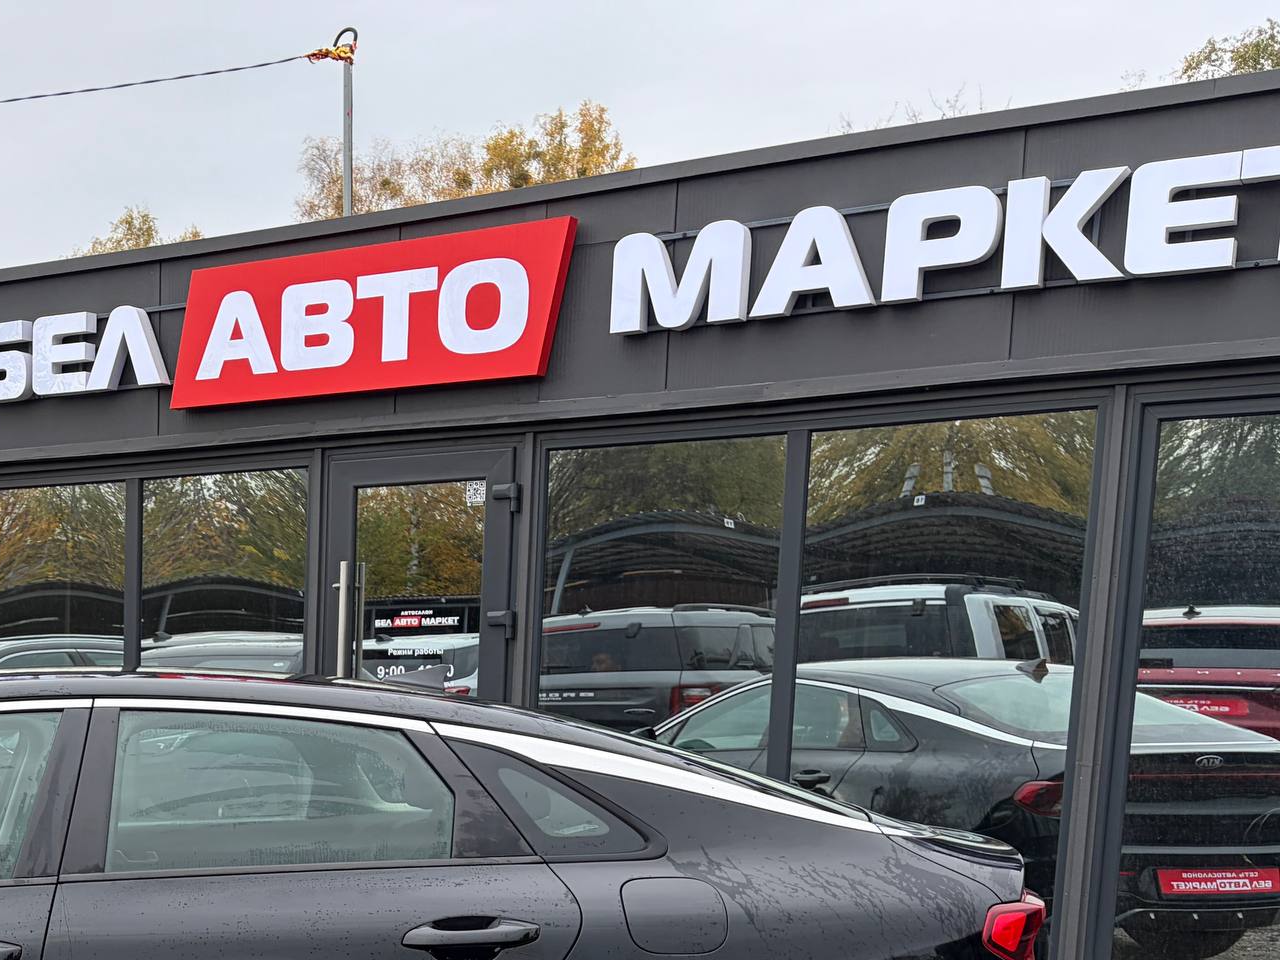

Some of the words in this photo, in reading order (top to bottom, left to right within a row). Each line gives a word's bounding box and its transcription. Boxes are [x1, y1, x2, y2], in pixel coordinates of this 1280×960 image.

[195, 257, 530, 381] АВТО
[374, 619, 392, 628] БЕЛ
[394, 617, 419, 626] АВТО
[421, 616, 460, 626] МАРКЕТ
[387, 648, 413, 656] Режим
[414, 648, 444, 656] работы
